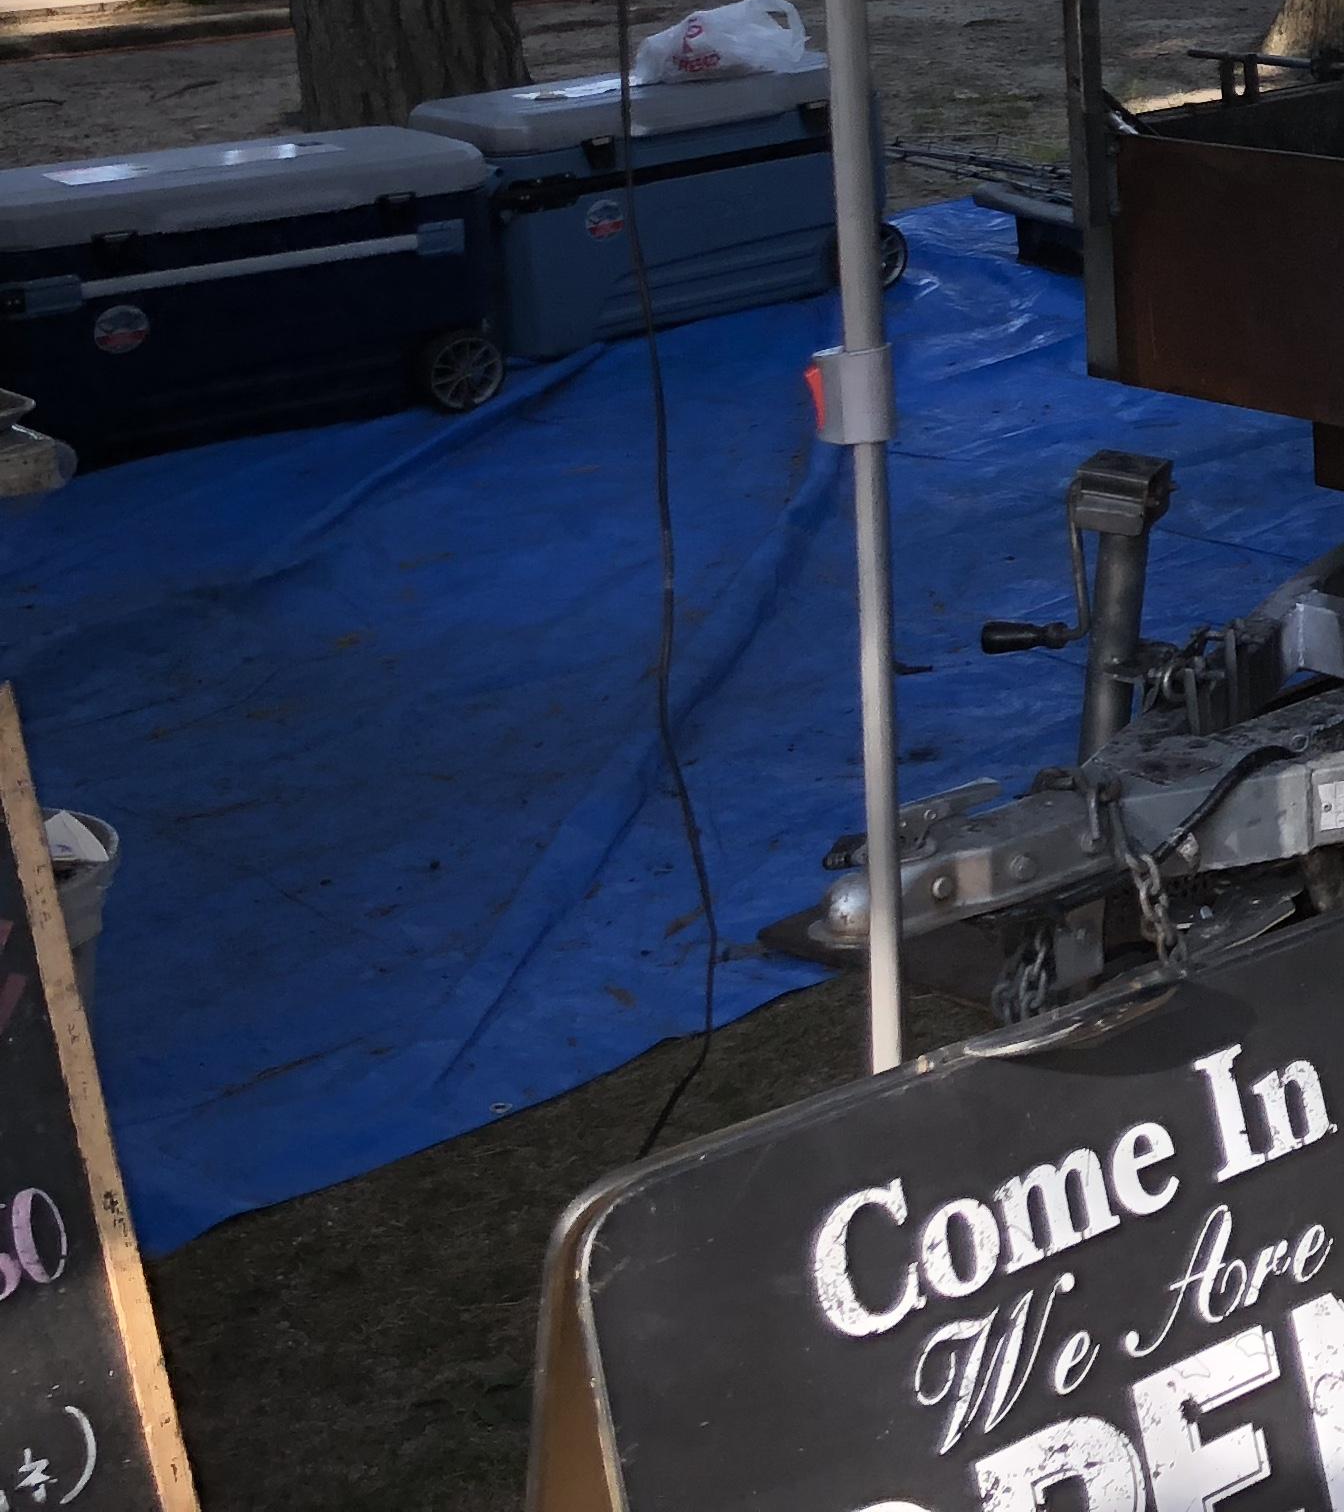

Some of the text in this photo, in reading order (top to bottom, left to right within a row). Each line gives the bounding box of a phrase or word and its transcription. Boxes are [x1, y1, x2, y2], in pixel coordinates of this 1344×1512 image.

[813, 1044, 1338, 1337] Come In
[915, 1204, 1334, 1457] We Are
